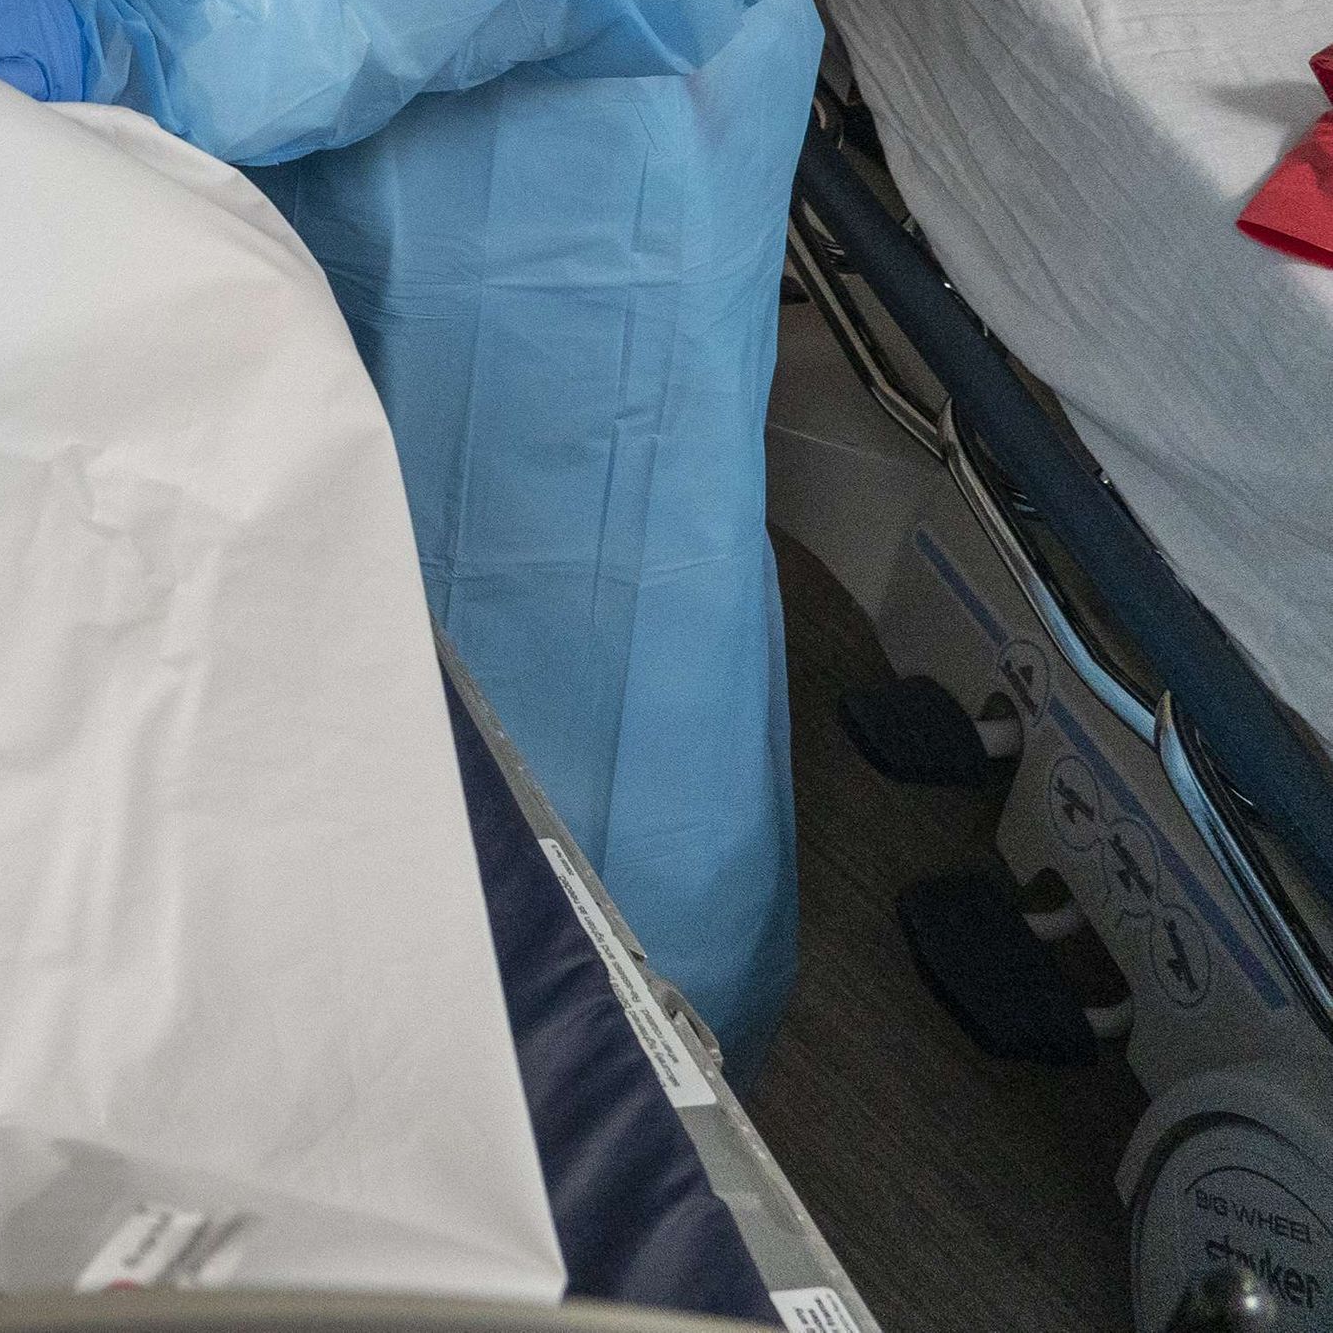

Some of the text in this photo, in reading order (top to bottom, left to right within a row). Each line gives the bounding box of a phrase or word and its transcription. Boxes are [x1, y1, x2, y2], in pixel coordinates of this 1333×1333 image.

[601, 944, 616, 960] and
[1195, 1189, 1312, 1245] BIG WHEEL
